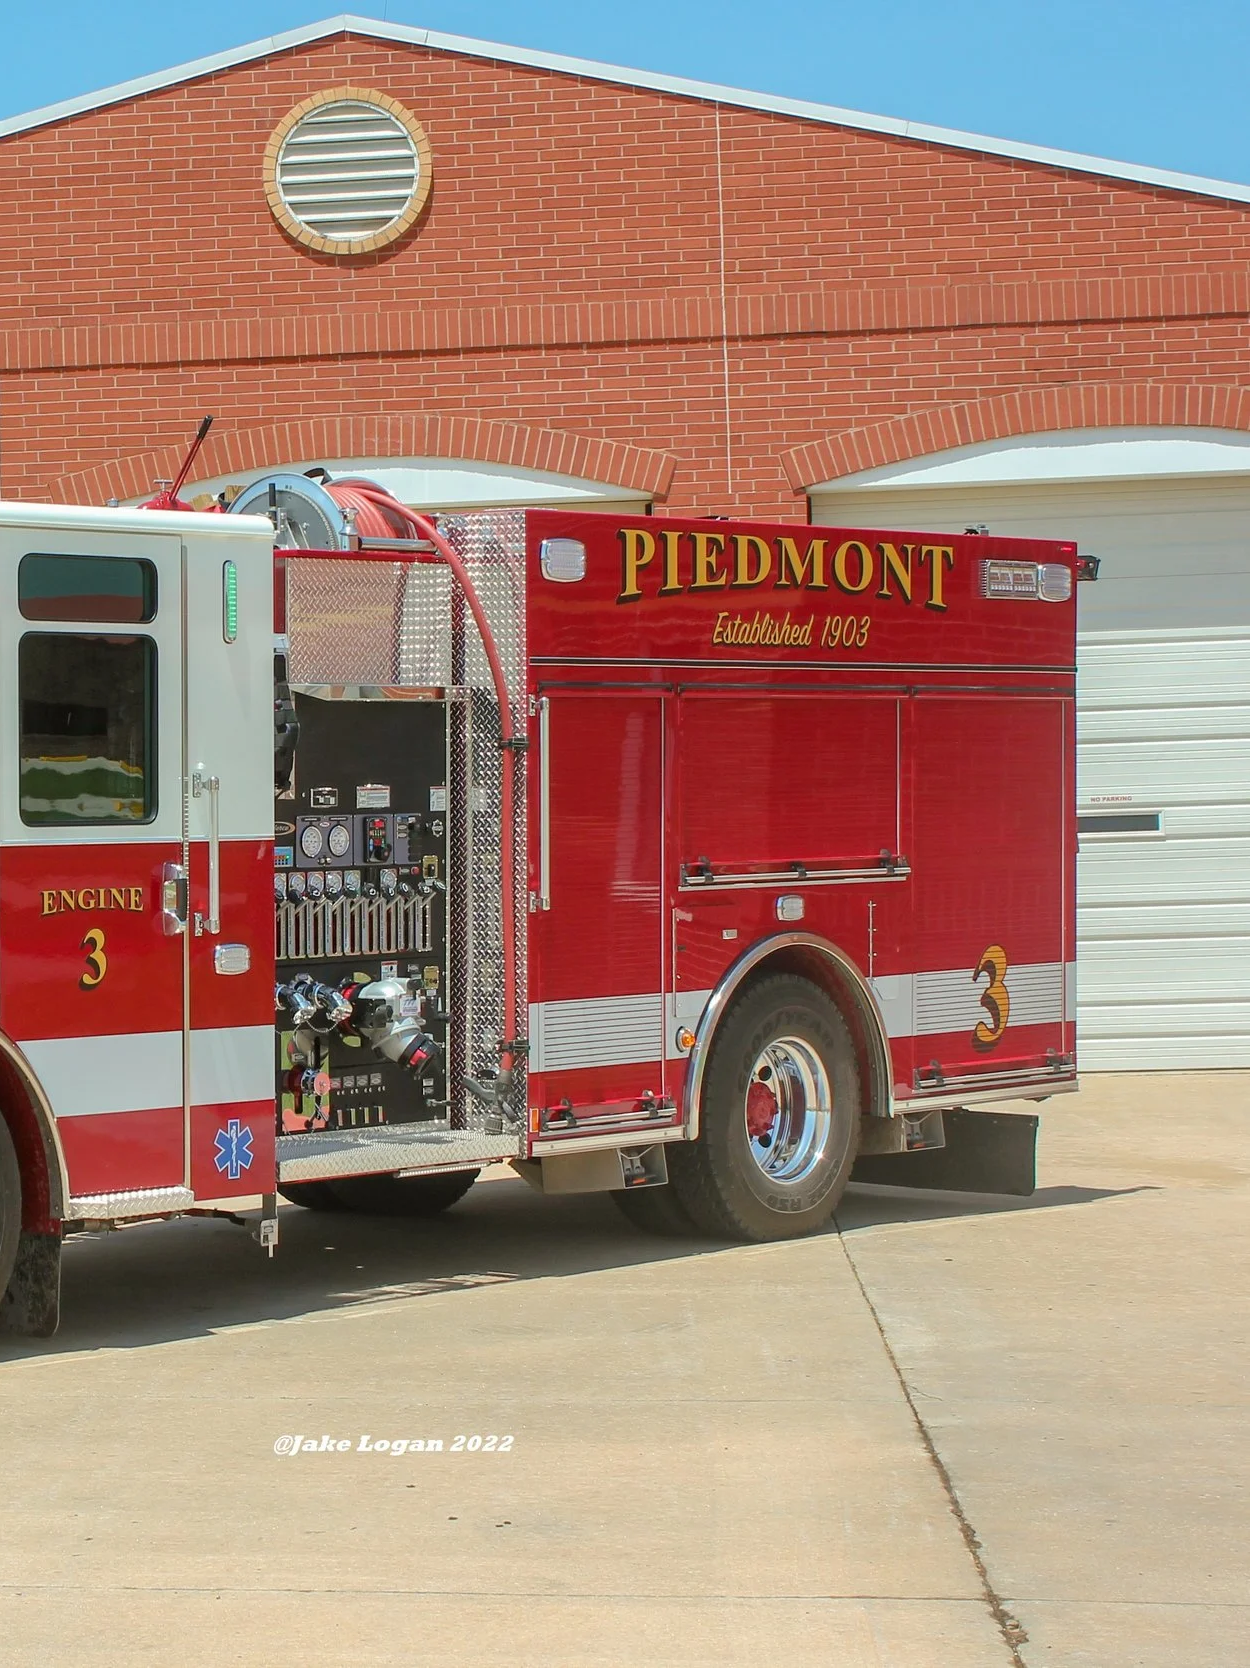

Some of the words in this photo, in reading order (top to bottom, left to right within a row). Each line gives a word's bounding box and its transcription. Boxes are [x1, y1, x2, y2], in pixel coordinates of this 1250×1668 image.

[616, 528, 954, 611] PIEDMONT
[712, 611, 814, 647] Established
[820, 615, 871, 648] 1903
[1101, 795, 1133, 803] PARKING
[40, 887, 144, 917] ENGINE
[79, 928, 107, 991] 3
[972, 944, 1010, 1053] 3
